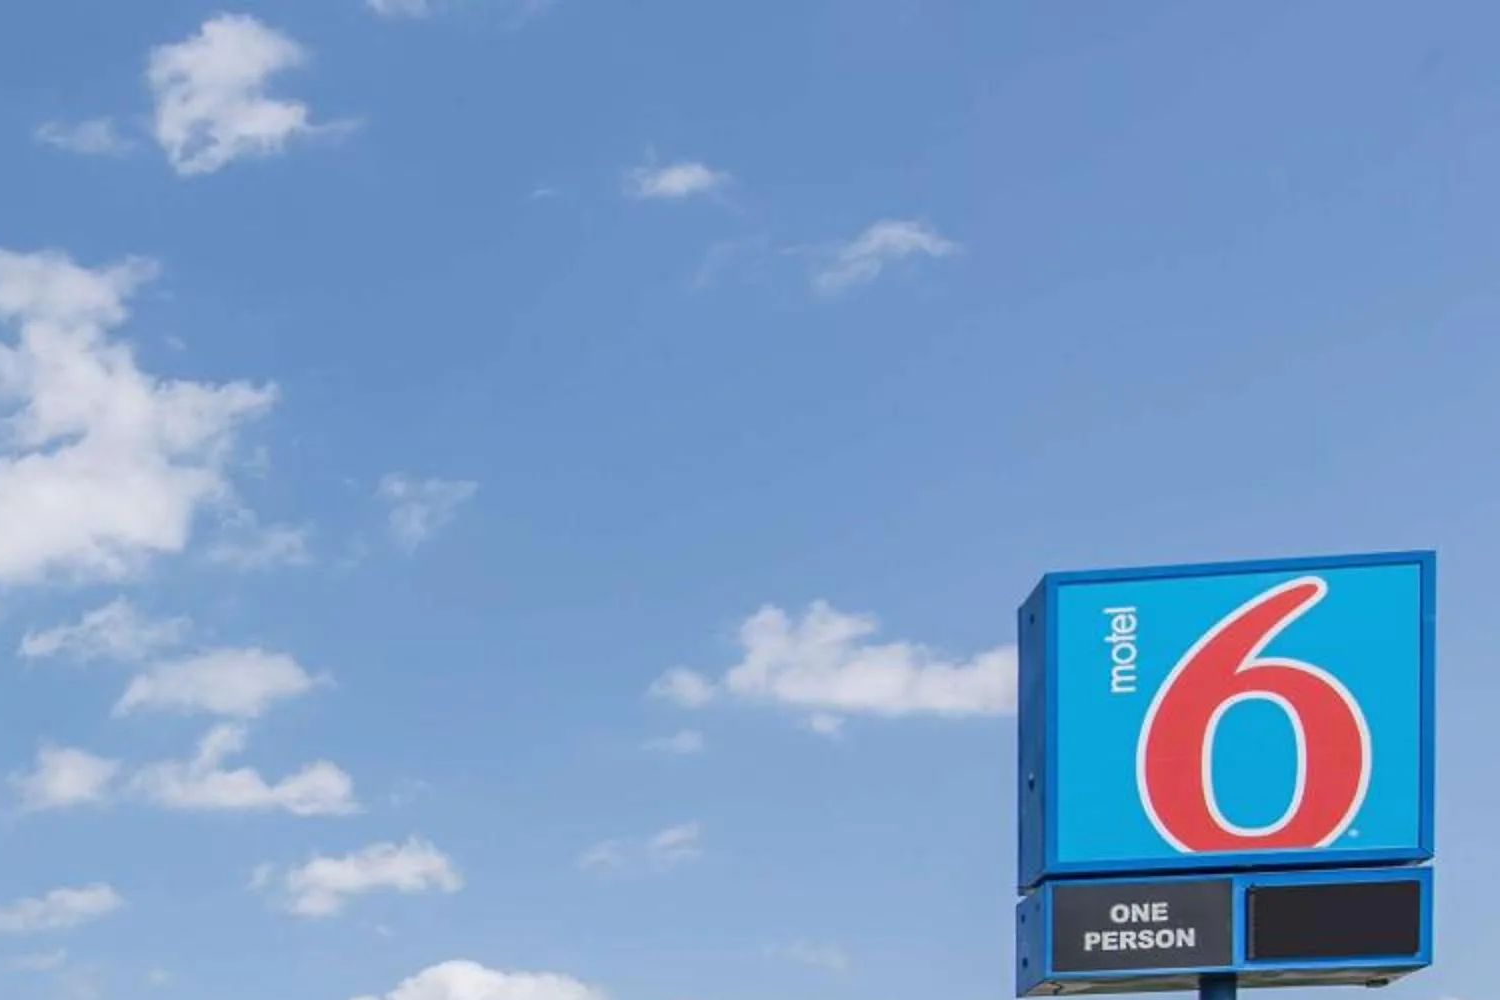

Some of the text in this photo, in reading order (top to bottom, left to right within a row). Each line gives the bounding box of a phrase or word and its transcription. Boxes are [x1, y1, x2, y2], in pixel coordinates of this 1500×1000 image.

[1103, 606, 1137, 693] motel
[1136, 575, 1372, 853] 6
[1084, 928, 1195, 952] PERSON
[1110, 902, 1168, 923] ONE
